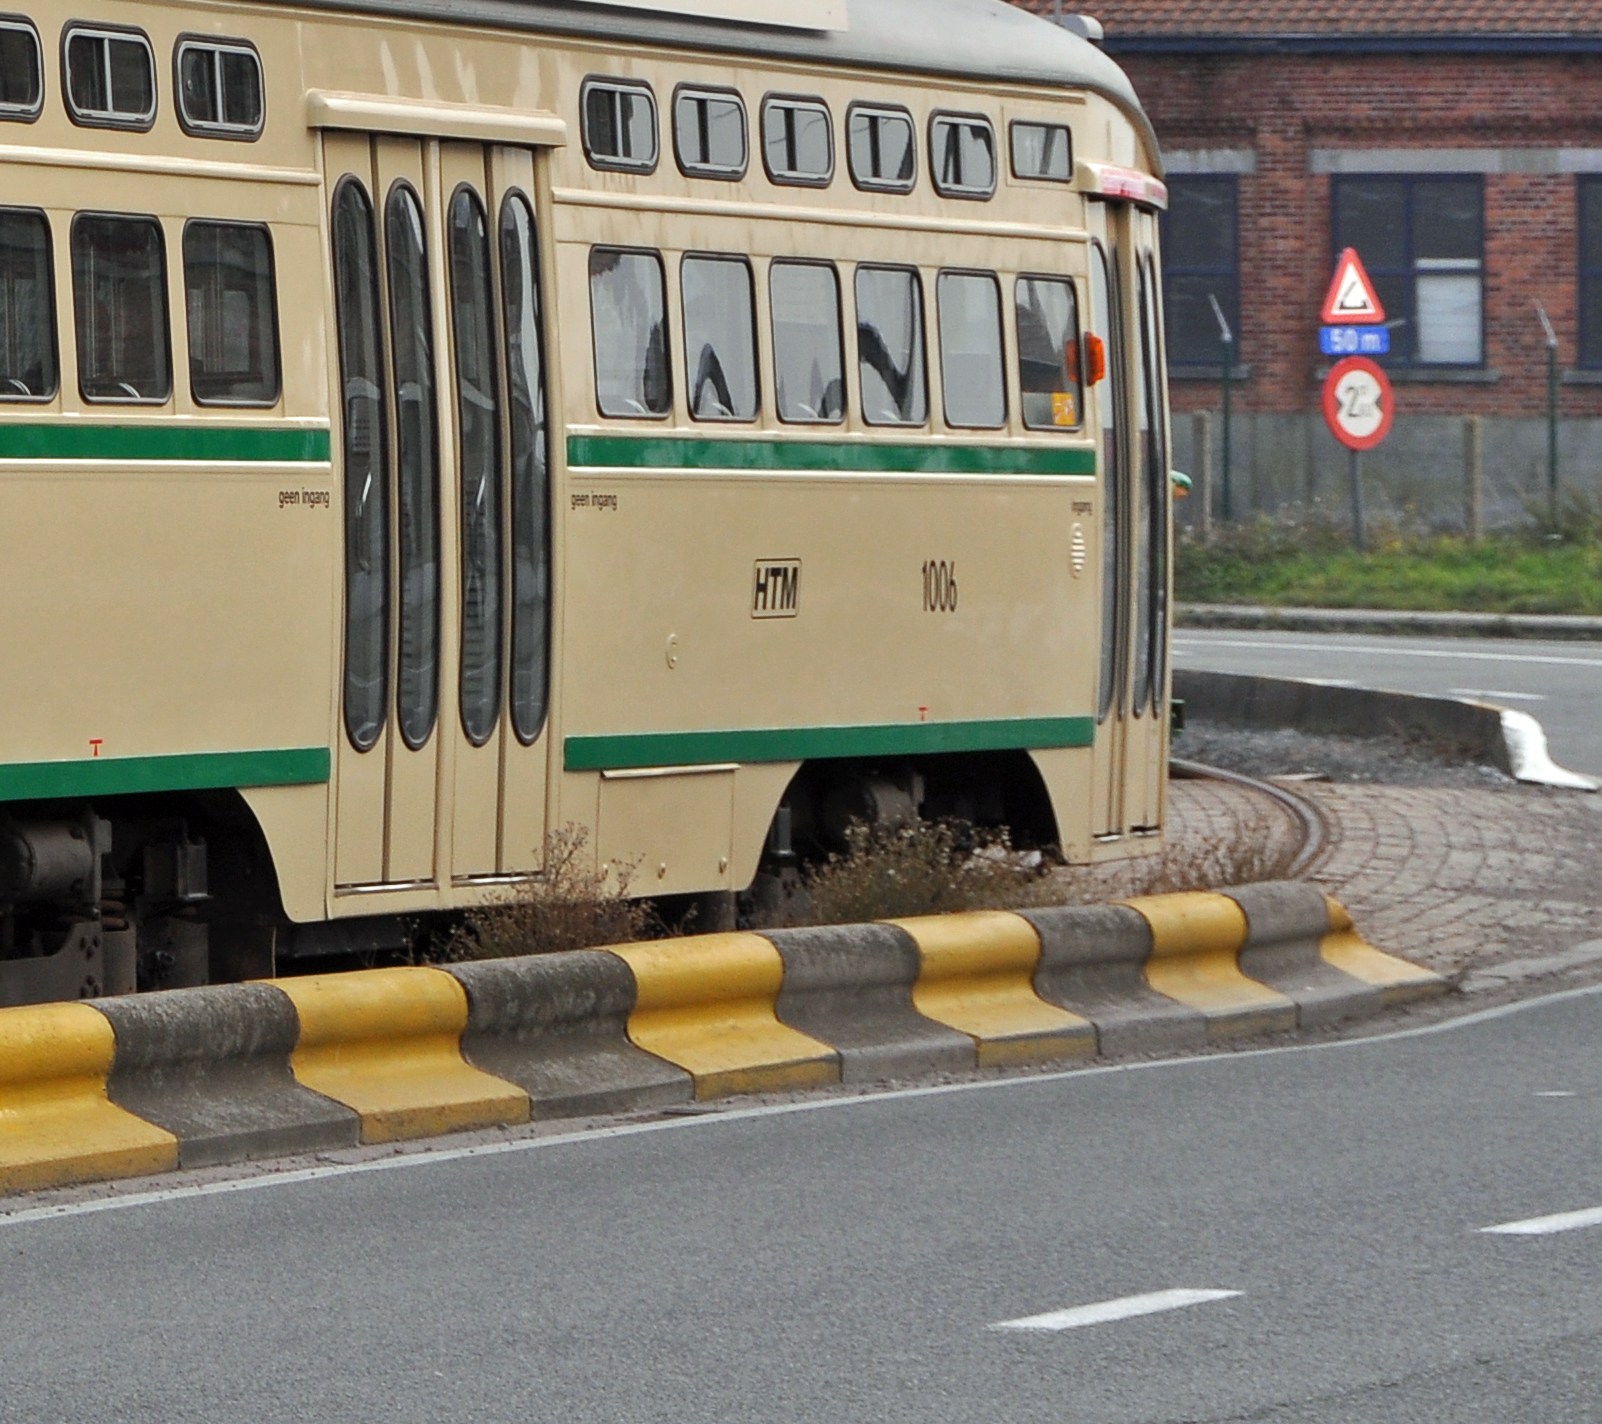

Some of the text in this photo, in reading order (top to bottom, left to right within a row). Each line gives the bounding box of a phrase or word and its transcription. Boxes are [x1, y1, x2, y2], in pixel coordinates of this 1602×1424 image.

[1329, 328, 1381, 352] 50 m
[278, 487, 330, 509] geen ingang
[571, 490, 618, 512] geen ingang
[753, 566, 799, 611] HTM
[921, 559, 958, 613] 1006
